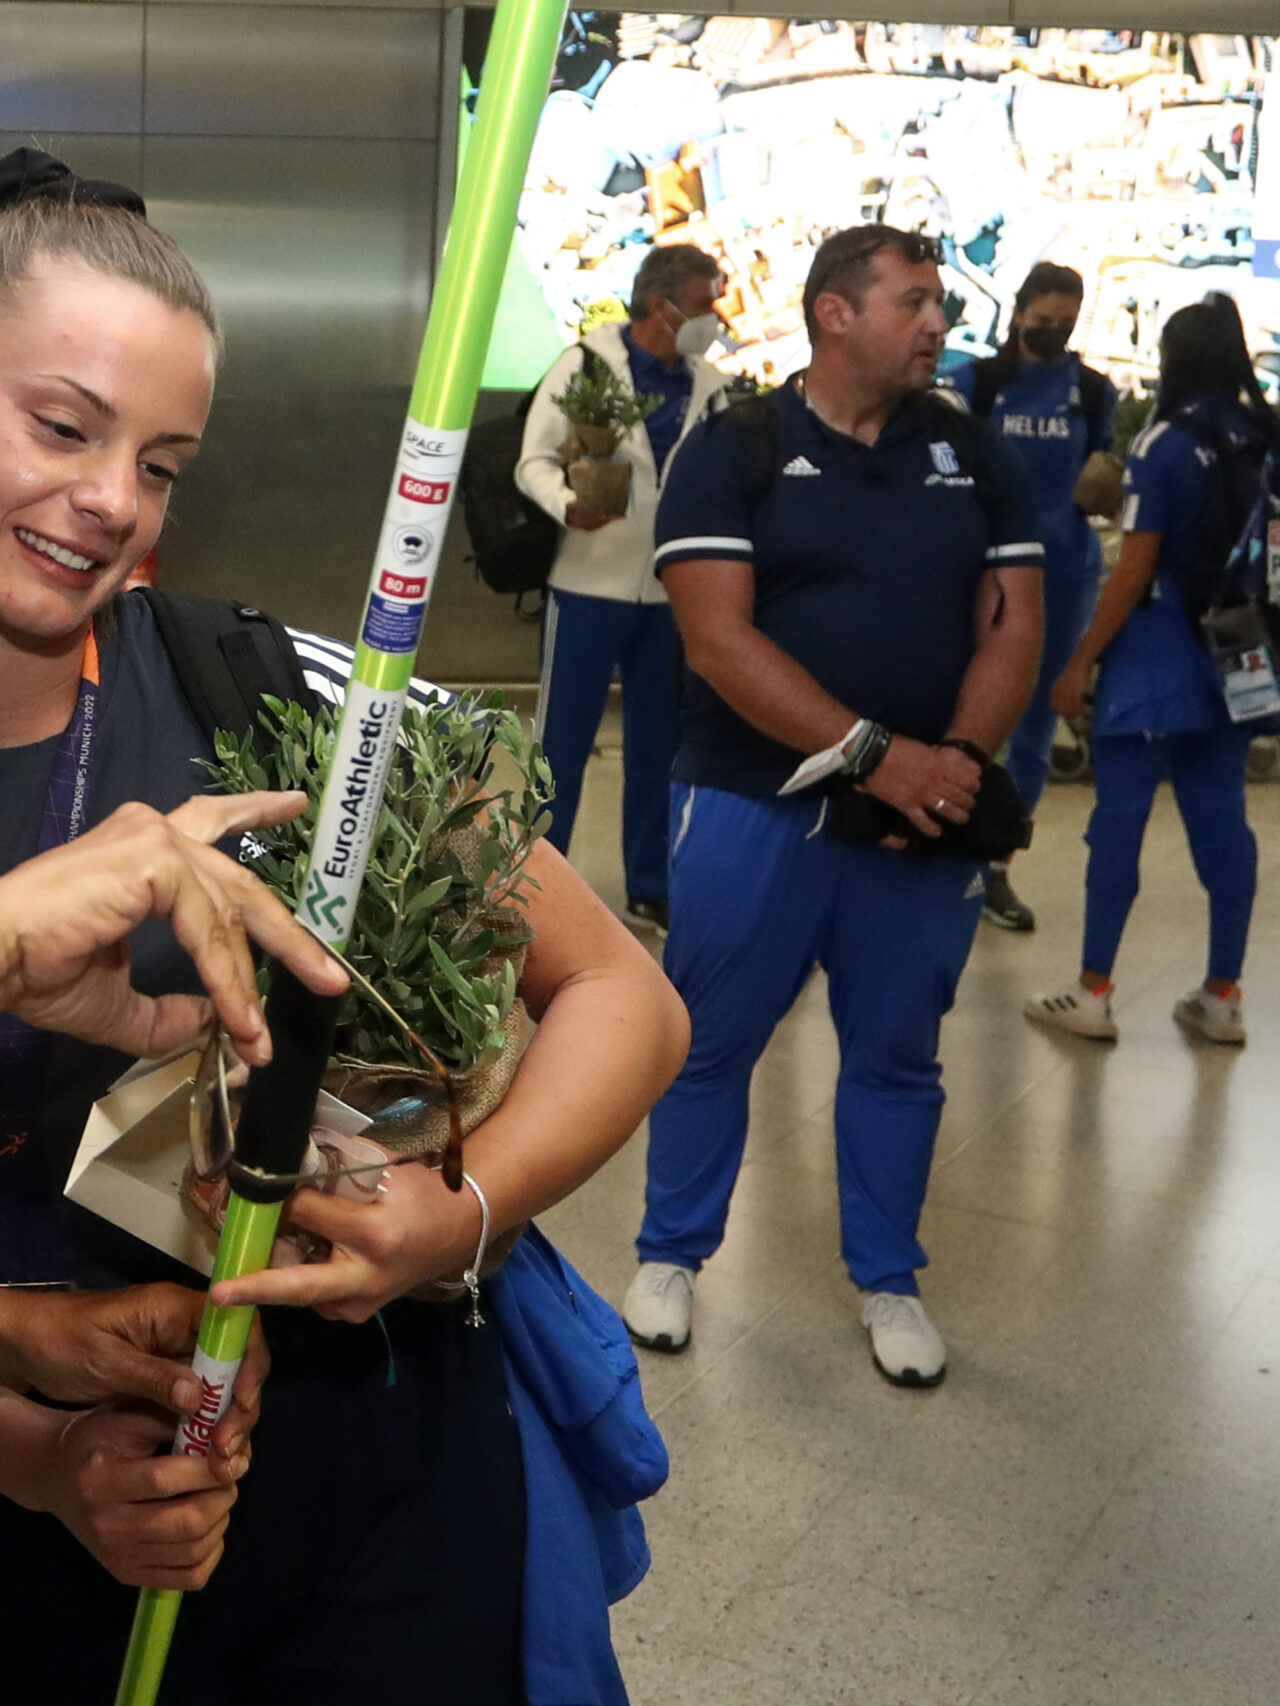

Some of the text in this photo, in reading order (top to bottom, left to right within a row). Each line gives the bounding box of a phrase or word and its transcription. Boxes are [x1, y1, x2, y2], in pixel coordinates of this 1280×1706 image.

[406, 431, 445, 452] SPACE
[405, 480, 444, 502] 600 g
[385, 577, 421, 594] 80 m
[84, 694, 95, 720] 2022
[79, 723, 93, 766] MUNICH
[323, 700, 387, 879] EuroAthletic
